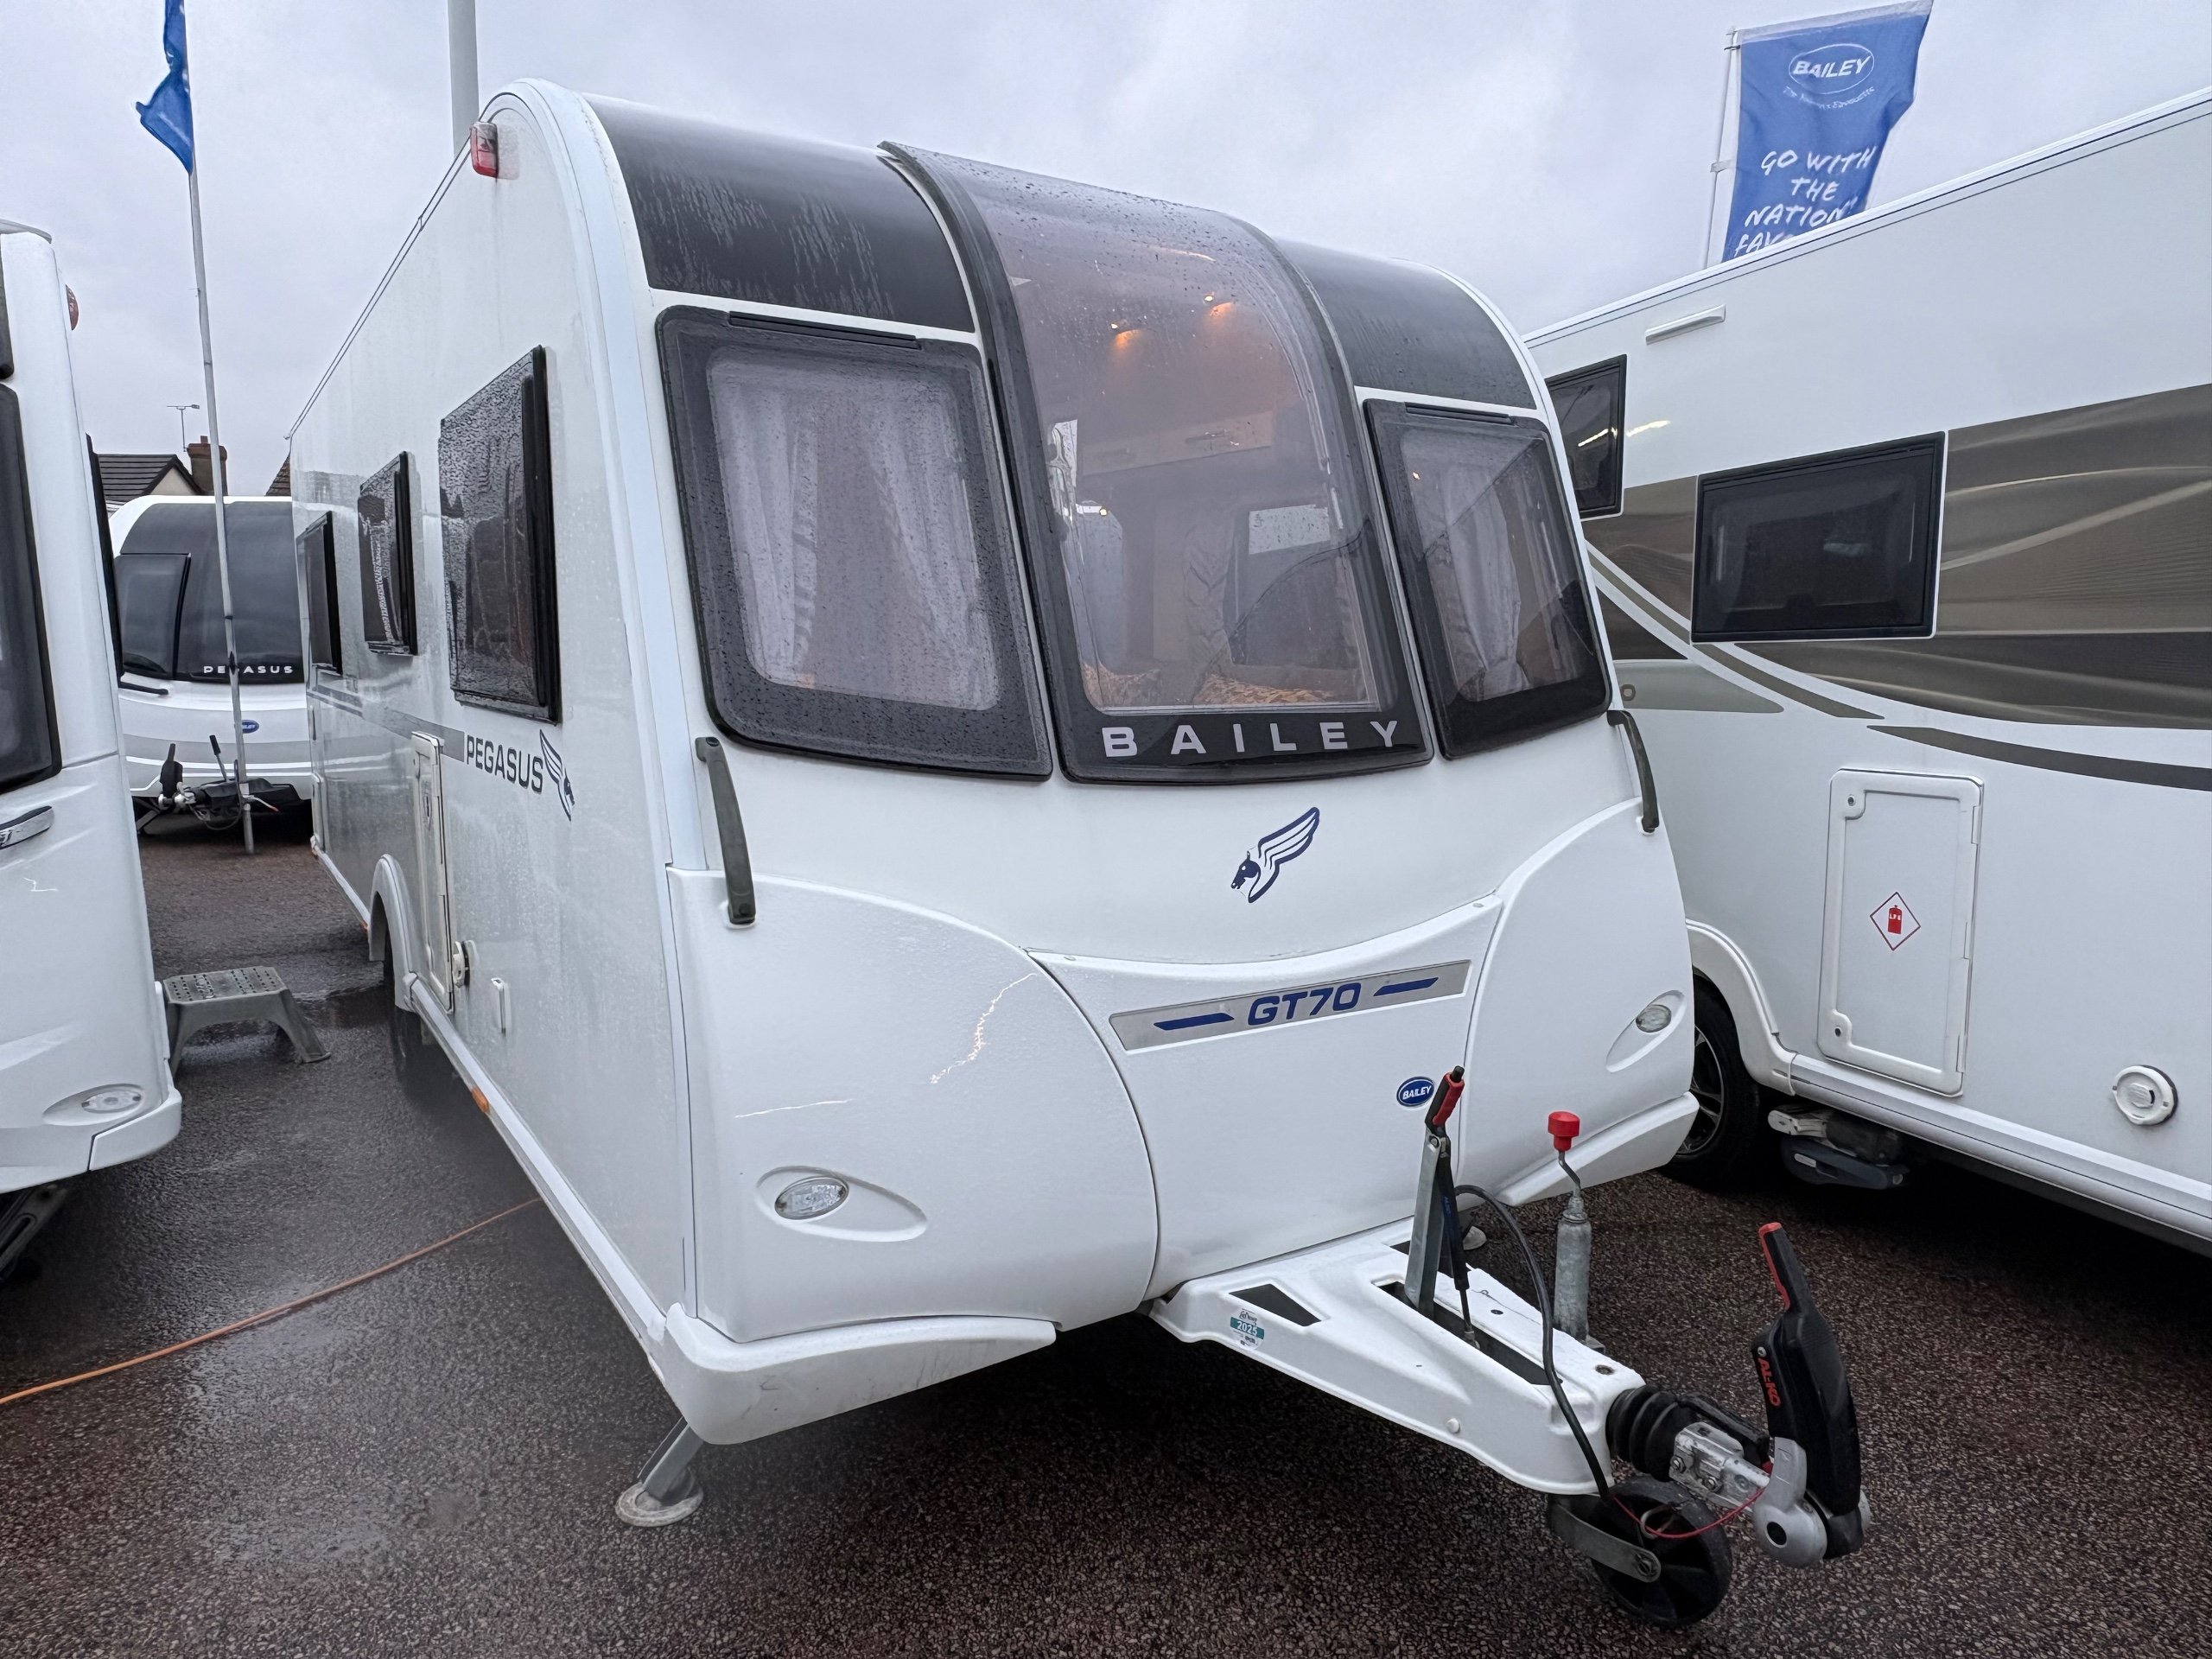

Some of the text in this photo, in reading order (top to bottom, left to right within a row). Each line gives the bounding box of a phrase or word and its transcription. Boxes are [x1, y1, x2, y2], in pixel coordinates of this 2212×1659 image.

[1793, 56, 1871, 78] BAILEY
[1761, 146, 1877, 175] GO WITH
[1791, 177, 1839, 201] THE
[203, 665, 293, 674] PEASUS
[1102, 721, 1397, 758] BAILEY
[467, 734, 543, 795] PEGASUS
[1247, 982, 1362, 1026] GT70
[1402, 1085, 1432, 1100] BAILEY
[1236, 1320, 1258, 1336] 2025
[1758, 1357, 1781, 1407] AL-KO
